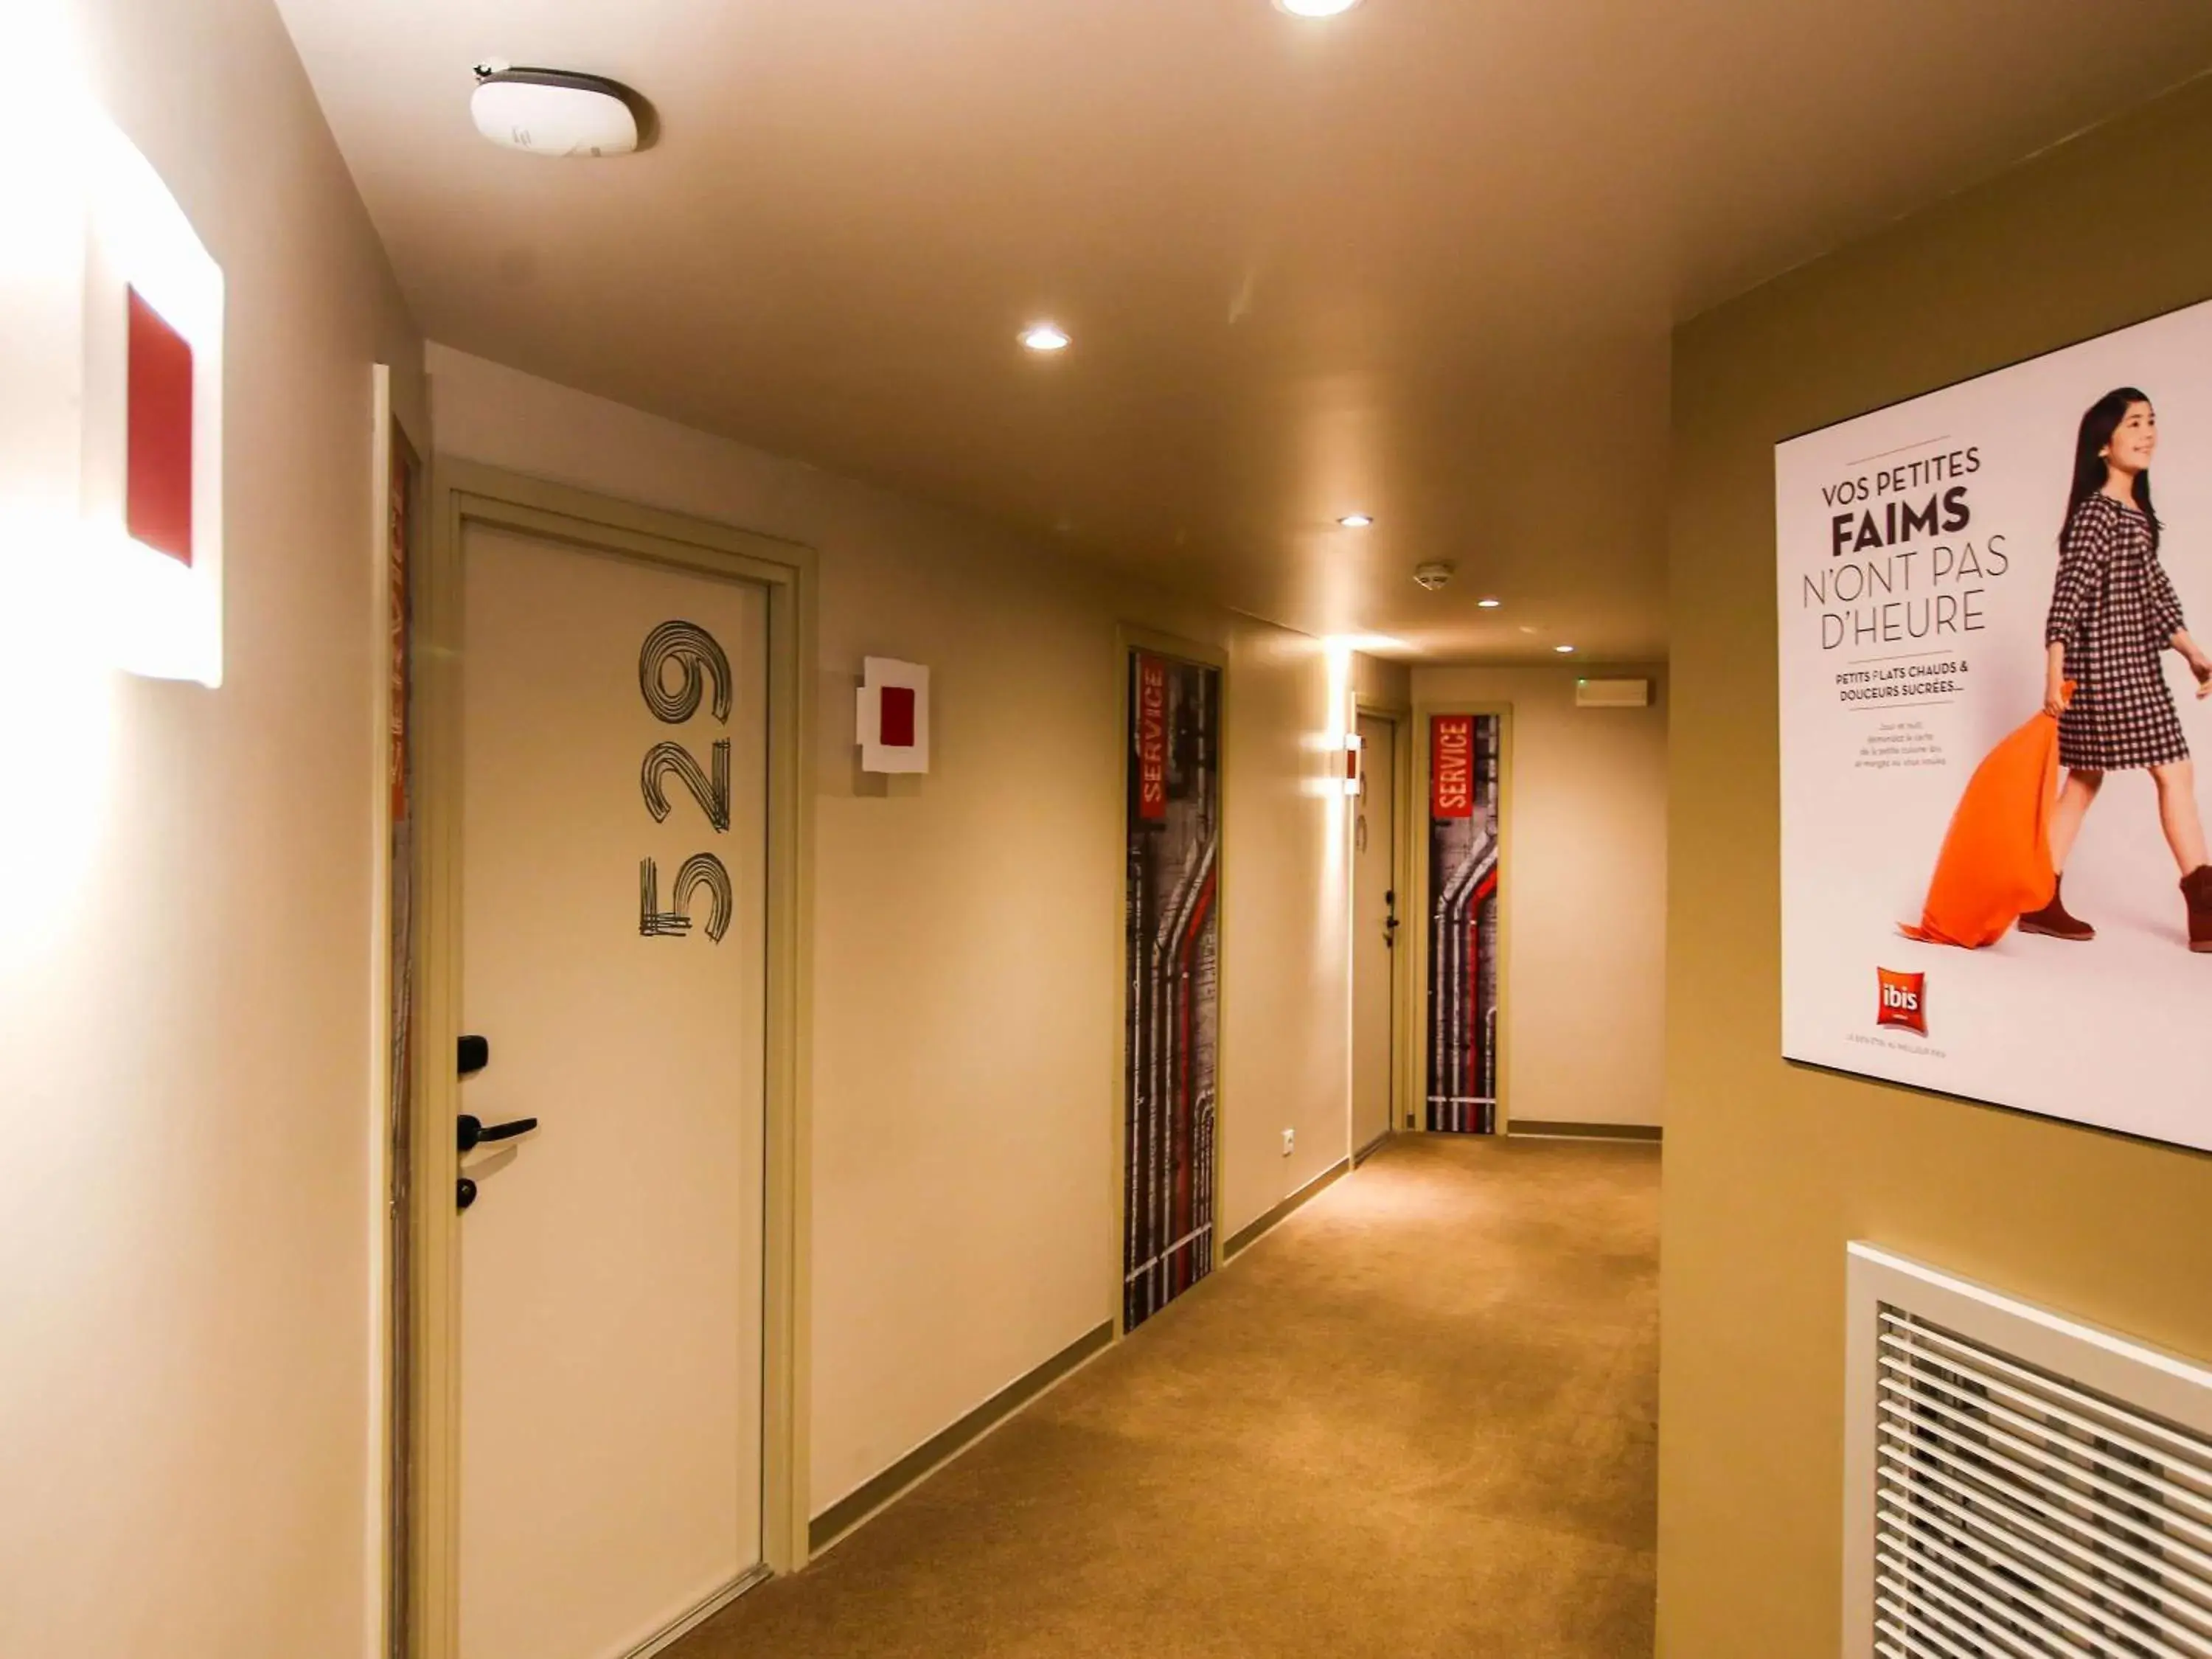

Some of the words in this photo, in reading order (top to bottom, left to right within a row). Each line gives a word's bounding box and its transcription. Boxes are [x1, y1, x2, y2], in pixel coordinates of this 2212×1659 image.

[1822, 477, 1869, 507] VOS
[1877, 447, 1980, 495] PETITES
[1832, 486, 1970, 557] FAIMS
[1804, 552, 1918, 608] N'ONT
[1933, 535, 2008, 586] PAS
[1822, 589, 1985, 650] D'HEURE
[1835, 671, 1871, 685] PETITS
[1872, 667, 1906, 681] PLATS
[1908, 661, 1957, 678] CHAUDS
[1959, 661, 1969, 672] &
[1840, 686, 1899, 701] DOUCEURS
[1144, 667, 1163, 803] SERVICE
[1439, 722, 1468, 808] SERVICE
[639, 620, 732, 945] 529
[1884, 984, 1918, 1010] ibis
